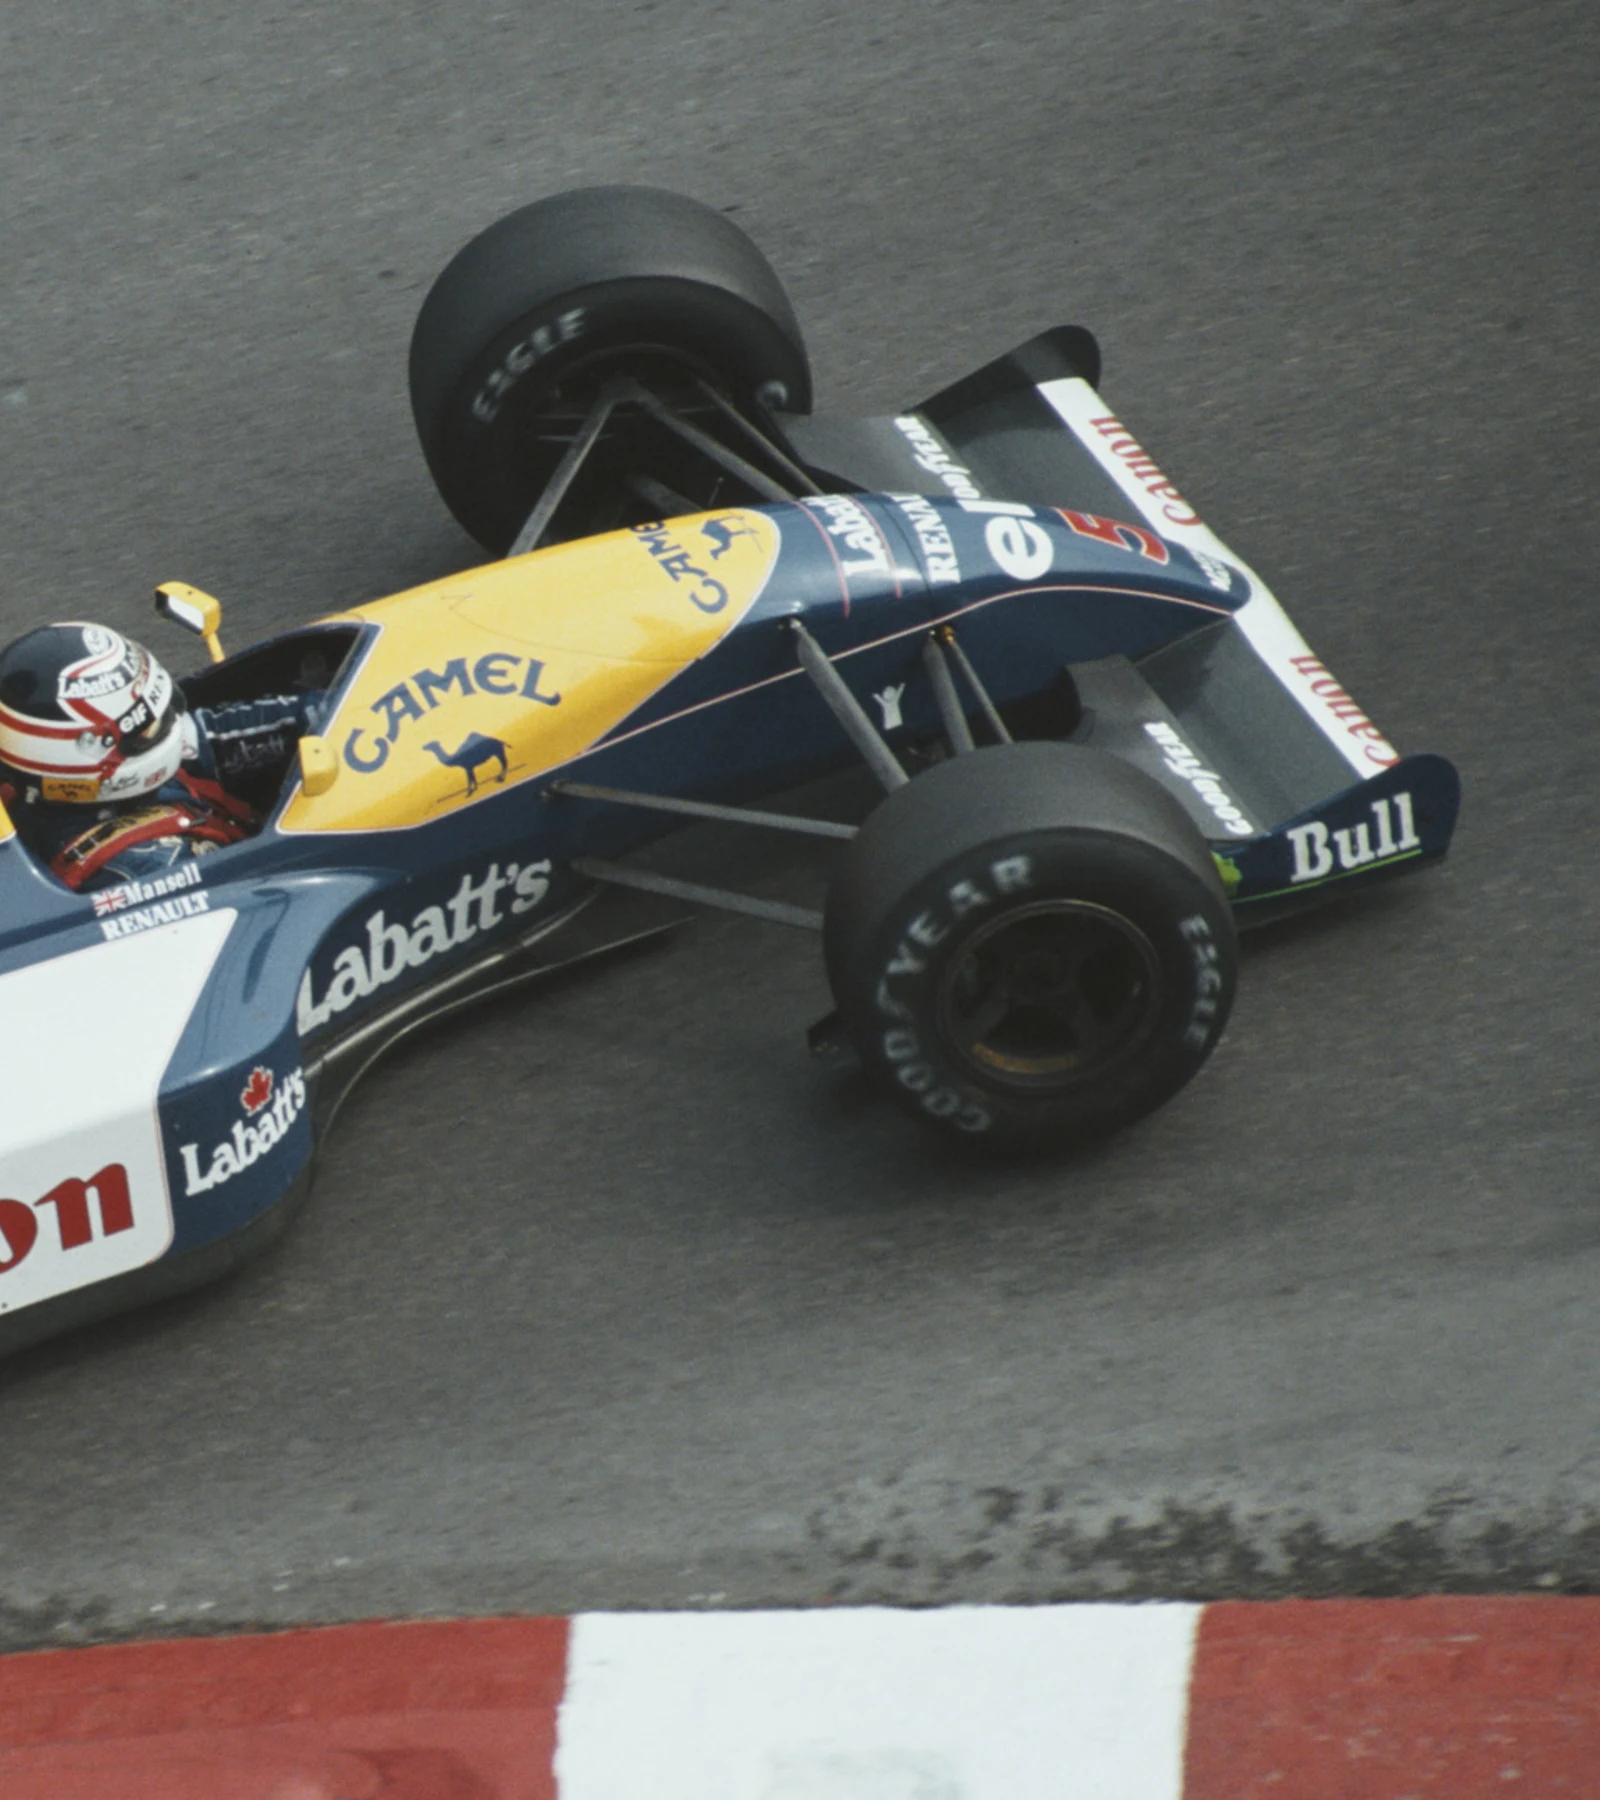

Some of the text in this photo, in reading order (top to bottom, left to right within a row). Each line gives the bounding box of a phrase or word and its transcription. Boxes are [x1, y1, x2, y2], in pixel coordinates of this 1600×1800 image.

[1089, 415, 1202, 526] Canon
[1055, 506, 1169, 566] 5
[118, 702, 150, 733] elf
[343, 652, 562, 774] CAMEL
[1289, 655, 1401, 769] Canon
[124, 862, 203, 906] Mansell
[1286, 791, 1421, 883] Bull
[100, 890, 209, 941] RENAULT
[296, 858, 552, 1038] Labatt's
[179, 1066, 306, 1197] Labatt's
